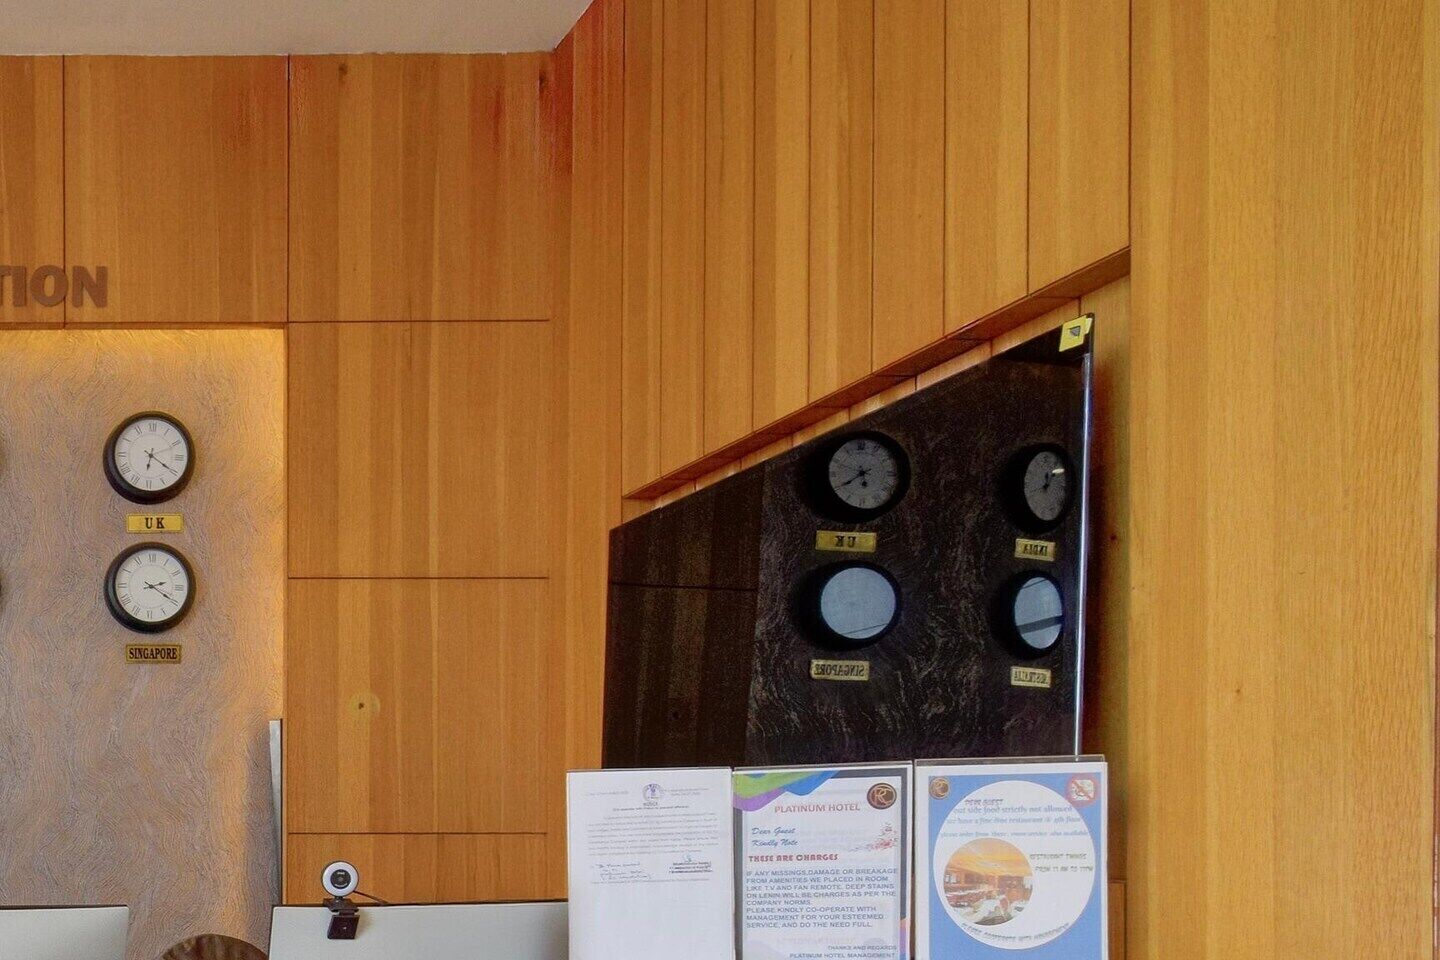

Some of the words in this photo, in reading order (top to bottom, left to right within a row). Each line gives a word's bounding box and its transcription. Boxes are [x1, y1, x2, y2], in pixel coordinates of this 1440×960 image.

[144, 517, 165, 529] UK
[129, 647, 178, 660] SINGAPORE
[774, 804, 826, 813] PLATINUM
[828, 803, 861, 812] HOTEL
[751, 827, 771, 835] Dear
[774, 827, 796, 836] Guest
[796, 853, 839, 861] CHARGES
